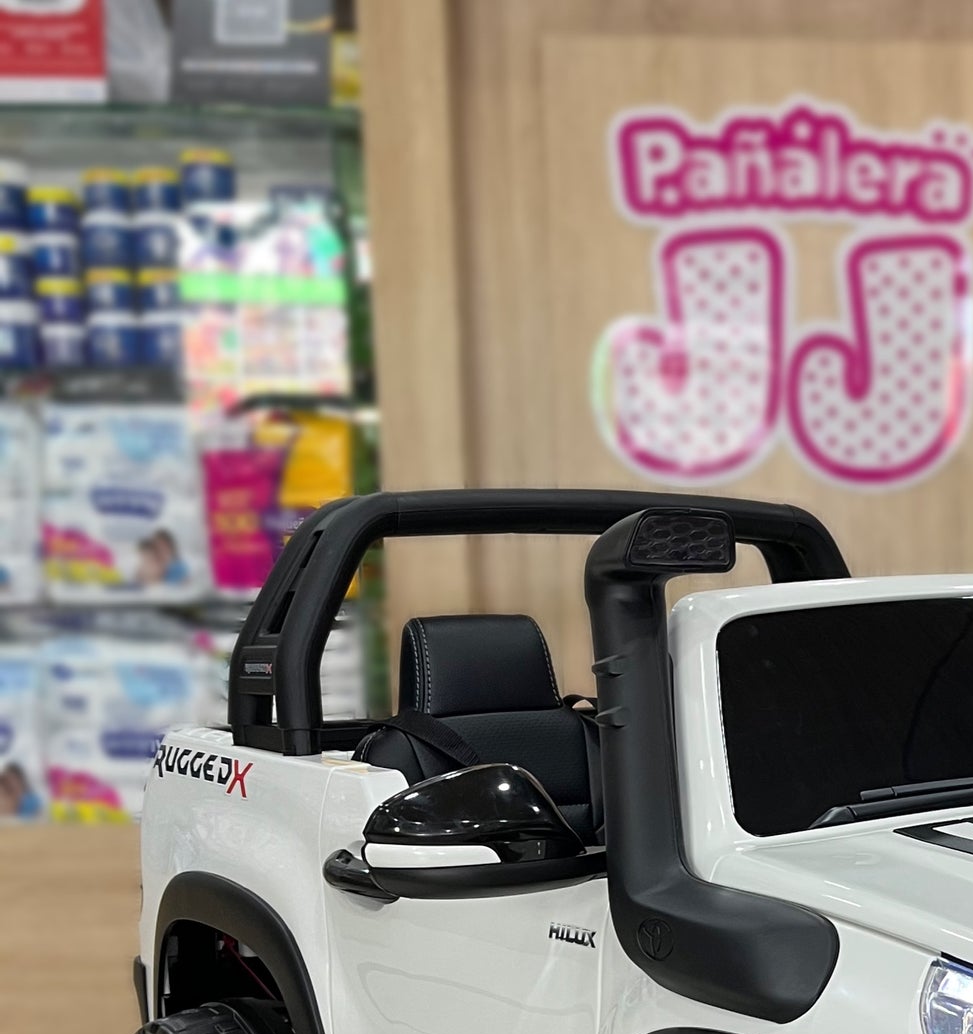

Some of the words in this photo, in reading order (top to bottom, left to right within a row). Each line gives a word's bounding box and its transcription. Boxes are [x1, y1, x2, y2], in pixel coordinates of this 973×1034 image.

[625, 114, 967, 216] Pañalera
[606, 228, 972, 485] JJ
[153, 744, 254, 798] RUGGEDX
[548, 921, 597, 949] HILUX
